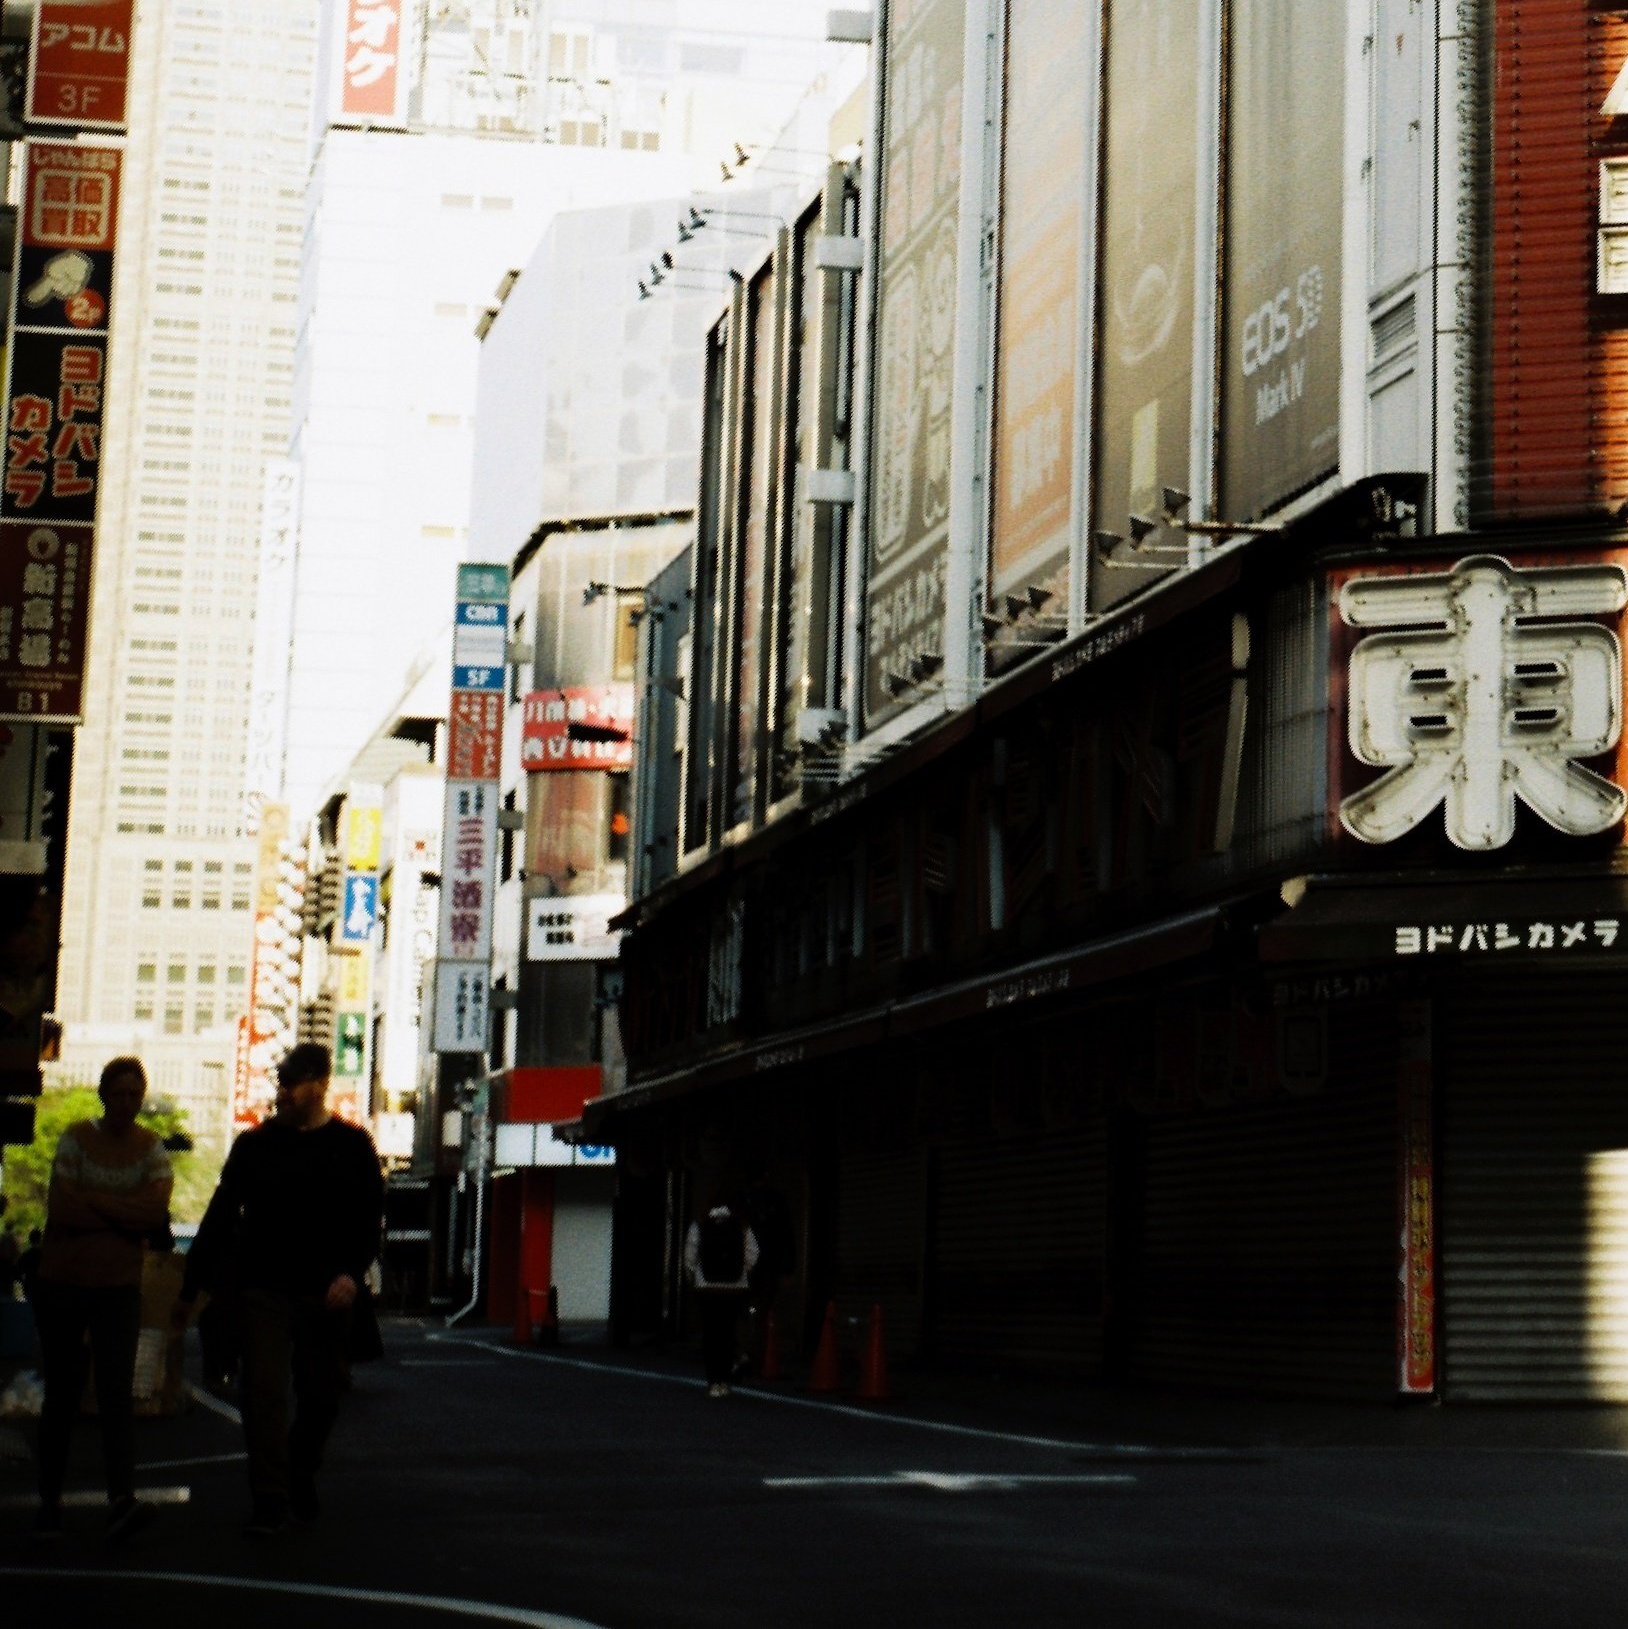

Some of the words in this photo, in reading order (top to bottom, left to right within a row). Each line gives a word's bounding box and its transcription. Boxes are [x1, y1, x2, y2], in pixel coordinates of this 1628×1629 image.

[39, 19, 127, 54] アコム
[57, 84, 102, 114] 3F
[1242, 285, 1291, 376] EOS
[53, 345, 103, 499] ヨドバシ
[1255, 368, 1290, 427] Mark
[5, 392, 54, 510] カメラ
[1395, 918, 1620, 956] ヨドバシカメラ
